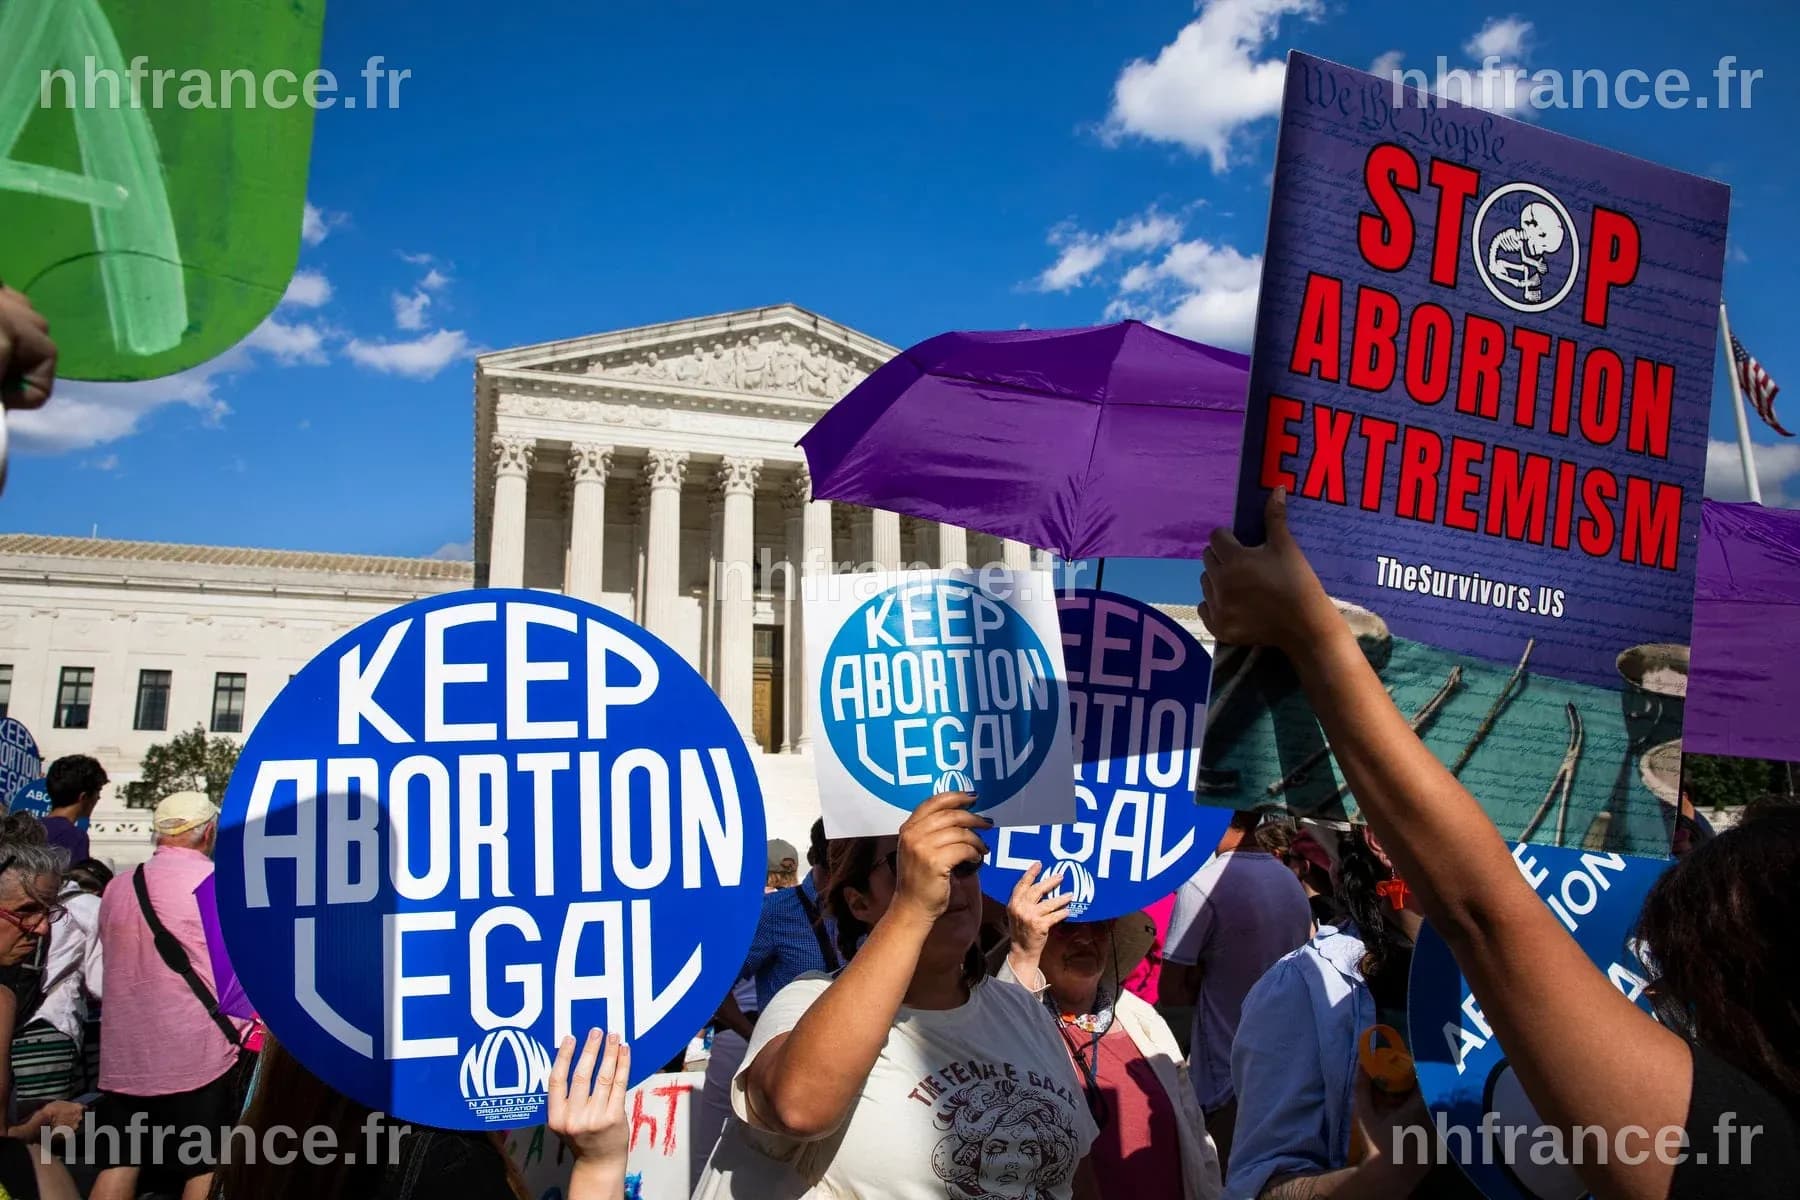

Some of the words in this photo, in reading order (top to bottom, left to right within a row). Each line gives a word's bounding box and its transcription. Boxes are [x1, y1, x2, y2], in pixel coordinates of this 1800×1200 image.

[1303, 62, 1350, 116] We
[1289, 271, 1676, 460] ABORTION
[1258, 394, 1685, 572] EXTREMISM
[866, 584, 1006, 649] KEEP
[1376, 555, 1566, 619] TheSurvivors.US
[338, 601, 660, 746] KEEP
[831, 648, 1050, 722] ABORTION
[856, 714, 1035, 787] LEGAL
[243, 747, 745, 909] ABORTION
[984, 784, 1196, 883] EGAL
[294, 899, 702, 1061] LEGAL
[459, 1029, 553, 1099] NOW
[907, 1075, 948, 1107] THE
[468, 1096, 545, 1108] NATIONAL
[475, 1105, 539, 1116] ORGANIZATION
